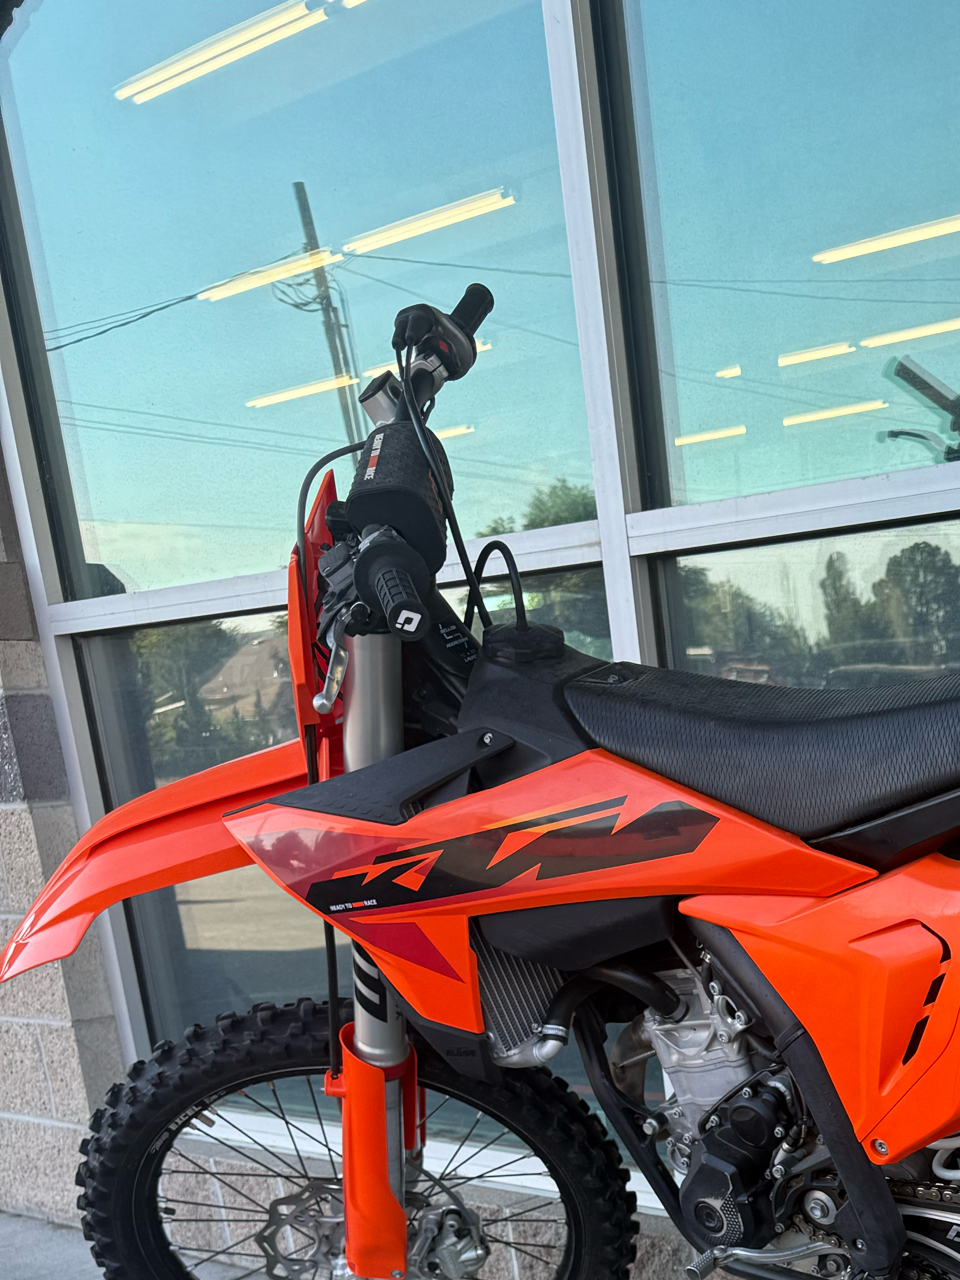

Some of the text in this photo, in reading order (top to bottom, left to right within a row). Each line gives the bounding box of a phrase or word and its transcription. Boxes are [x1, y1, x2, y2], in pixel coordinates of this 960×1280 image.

[344, 902, 353, 910] TO
[363, 898, 378, 907] RACE
[168, 1105, 203, 1131] EXCEL
